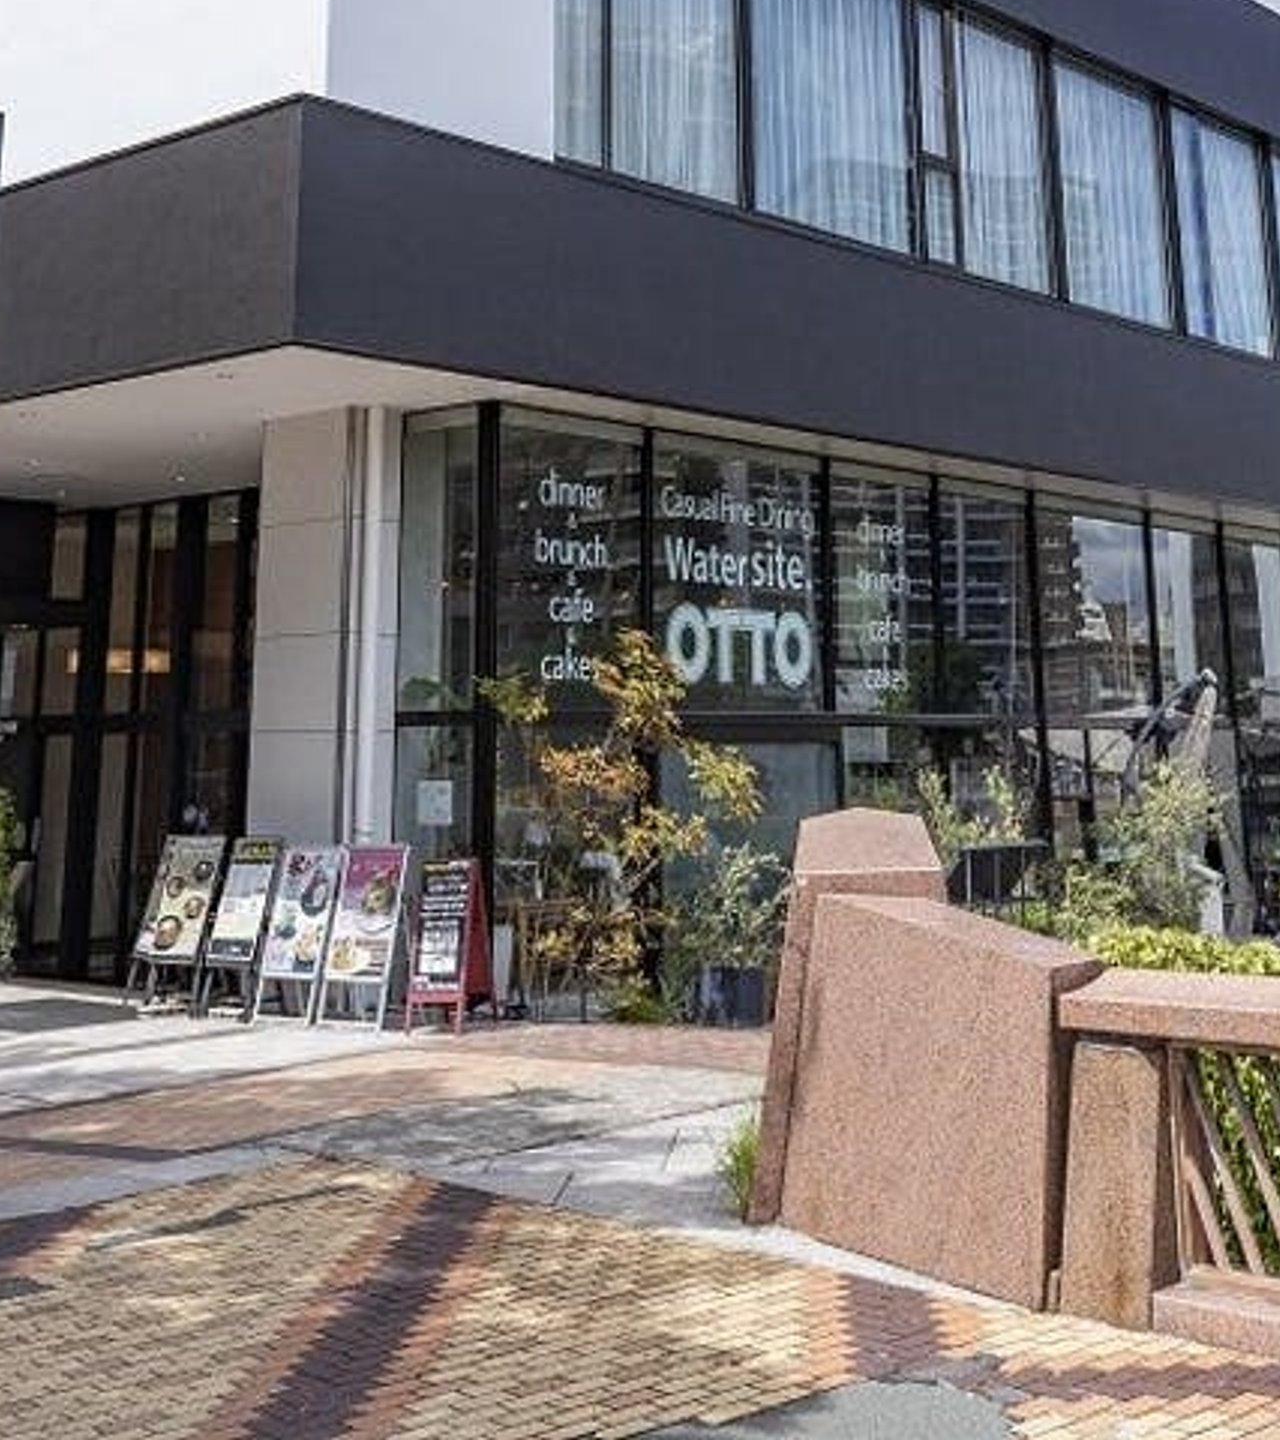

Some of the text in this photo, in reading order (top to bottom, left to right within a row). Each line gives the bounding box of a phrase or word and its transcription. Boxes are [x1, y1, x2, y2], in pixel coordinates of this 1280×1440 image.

[539, 467, 606, 510] dinner
[661, 485, 816, 539] Casual Fine Dining
[535, 528, 609, 570] brunch
[549, 588, 594, 623] cafe
[666, 602, 813, 690] OTTO
